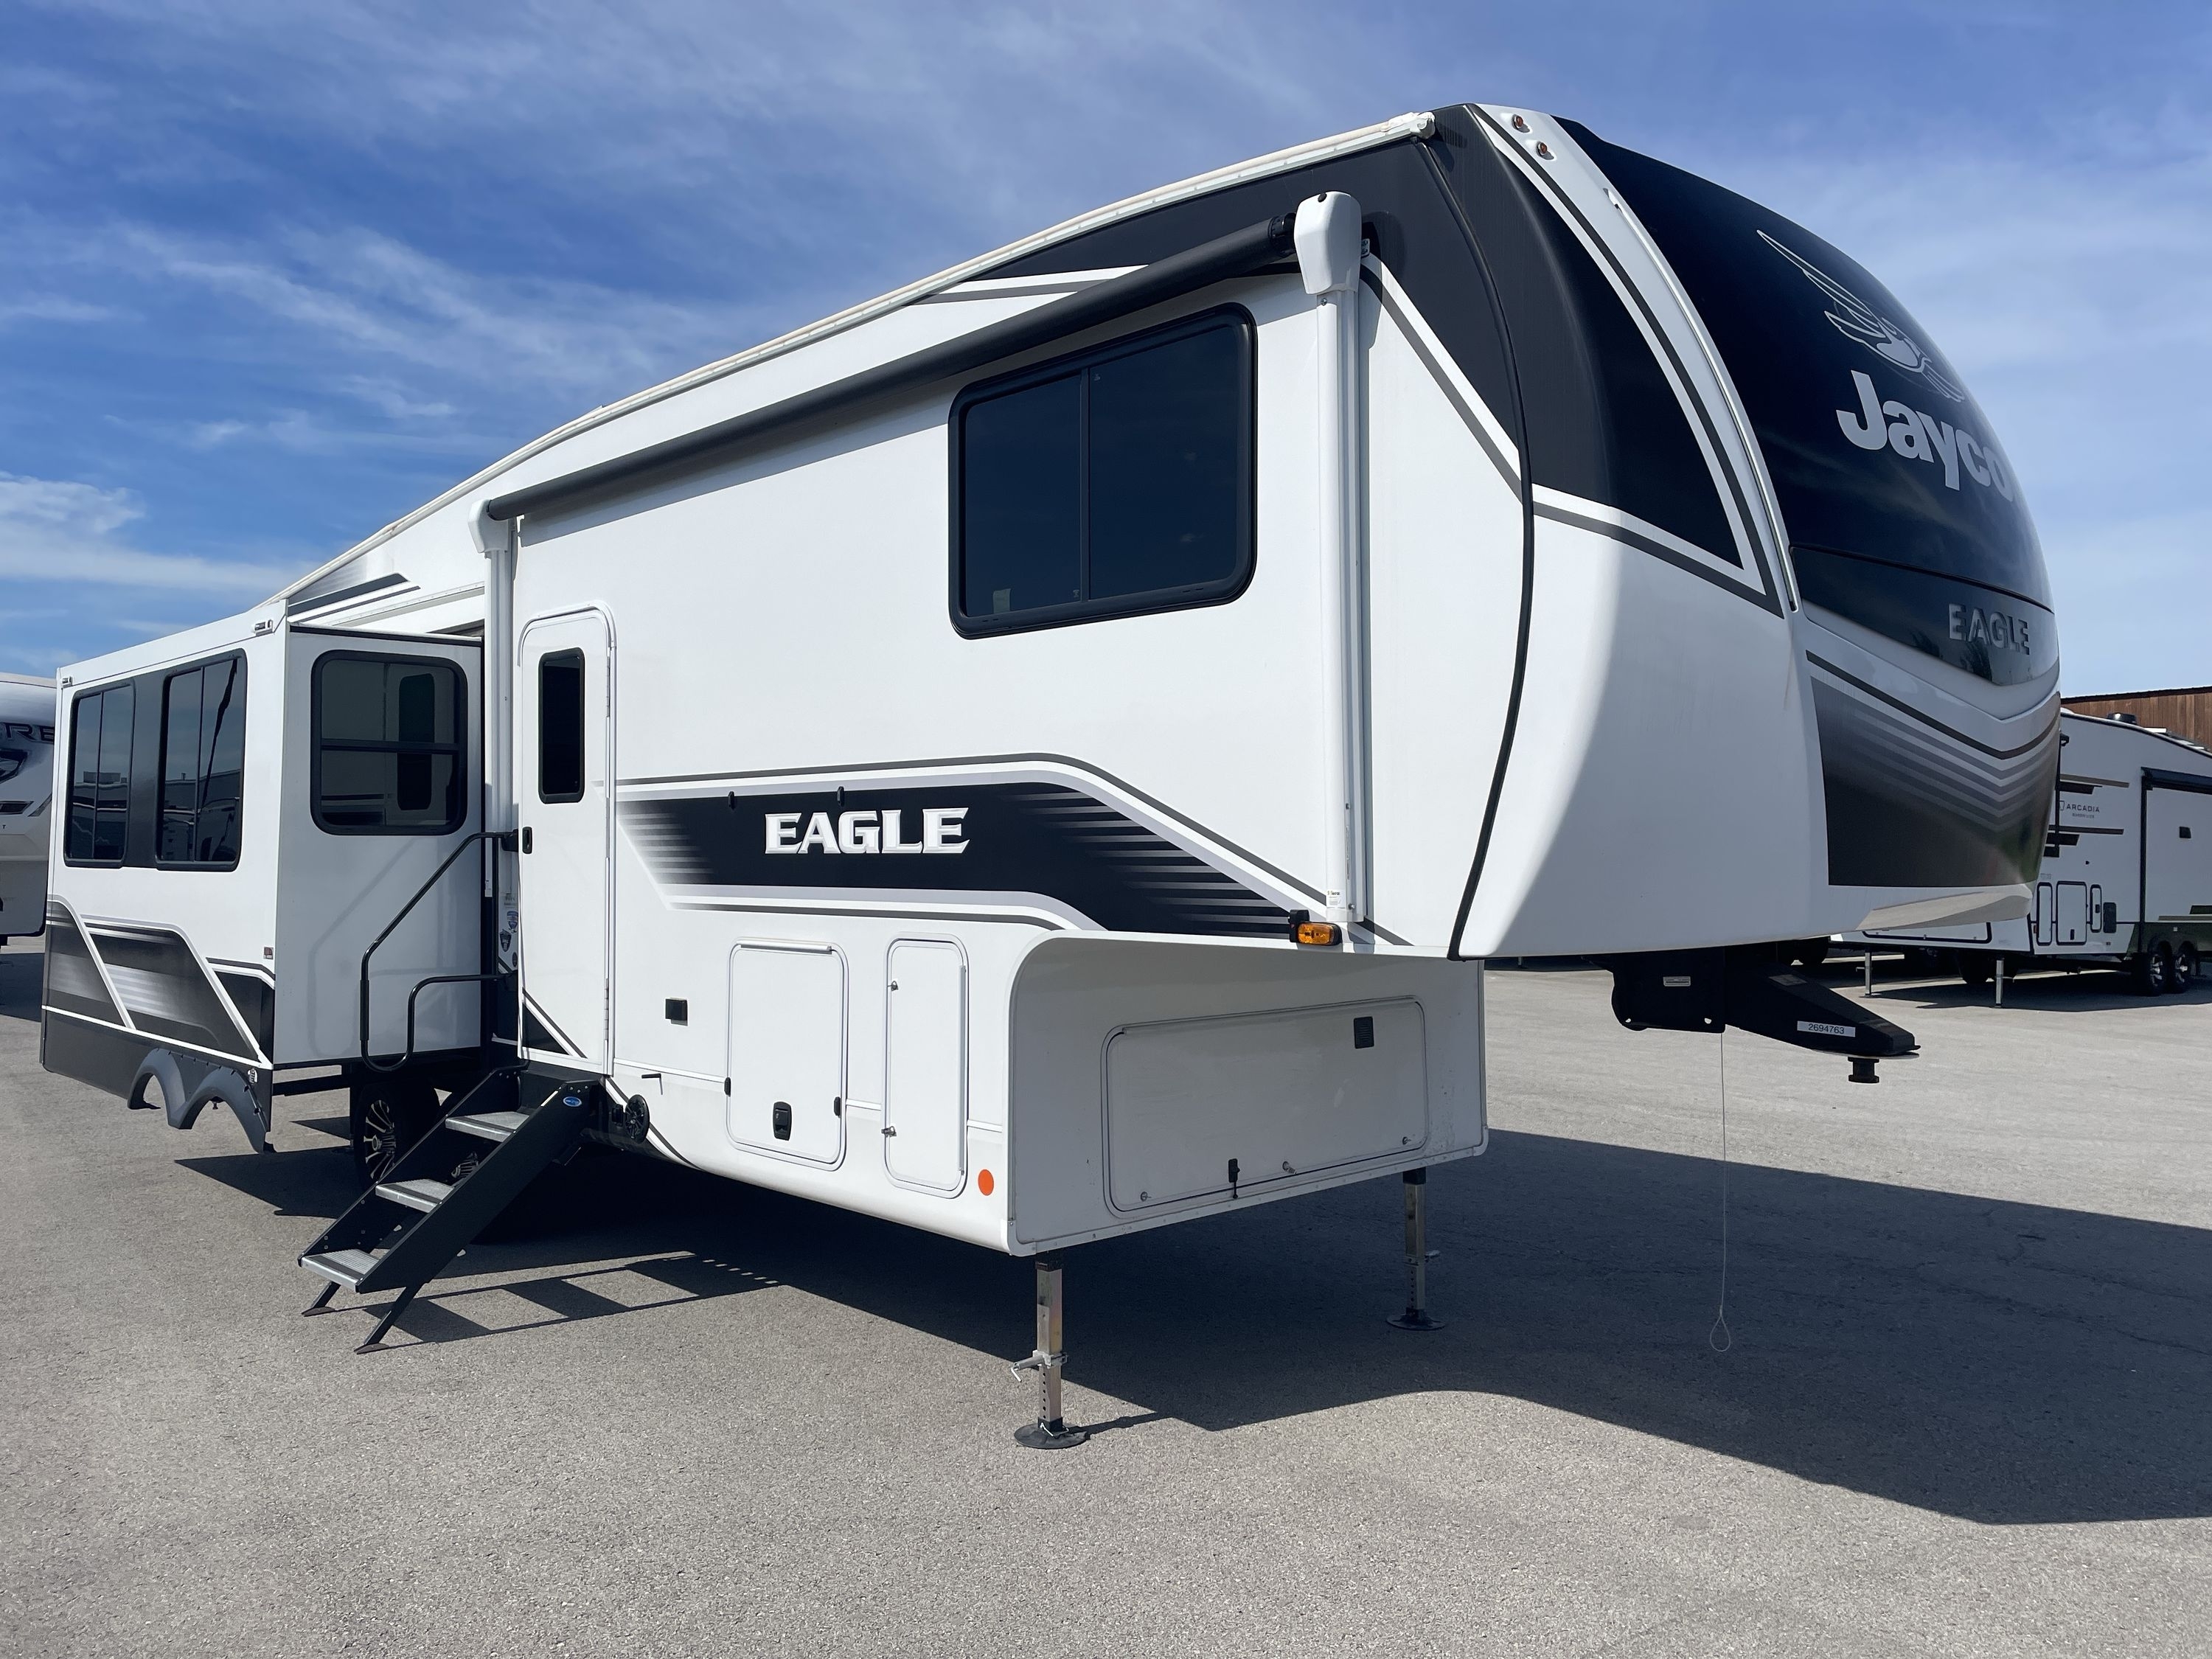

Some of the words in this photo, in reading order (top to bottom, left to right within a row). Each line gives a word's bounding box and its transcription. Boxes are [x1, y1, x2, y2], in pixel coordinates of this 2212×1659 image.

[1836, 370, 2014, 501] Jayco
[1949, 603, 2030, 655] EAGLE
[765, 807, 970, 855] EAGLE
[2066, 804, 2100, 813] ARCADIA
[1808, 1023, 1845, 1034] 2694763
